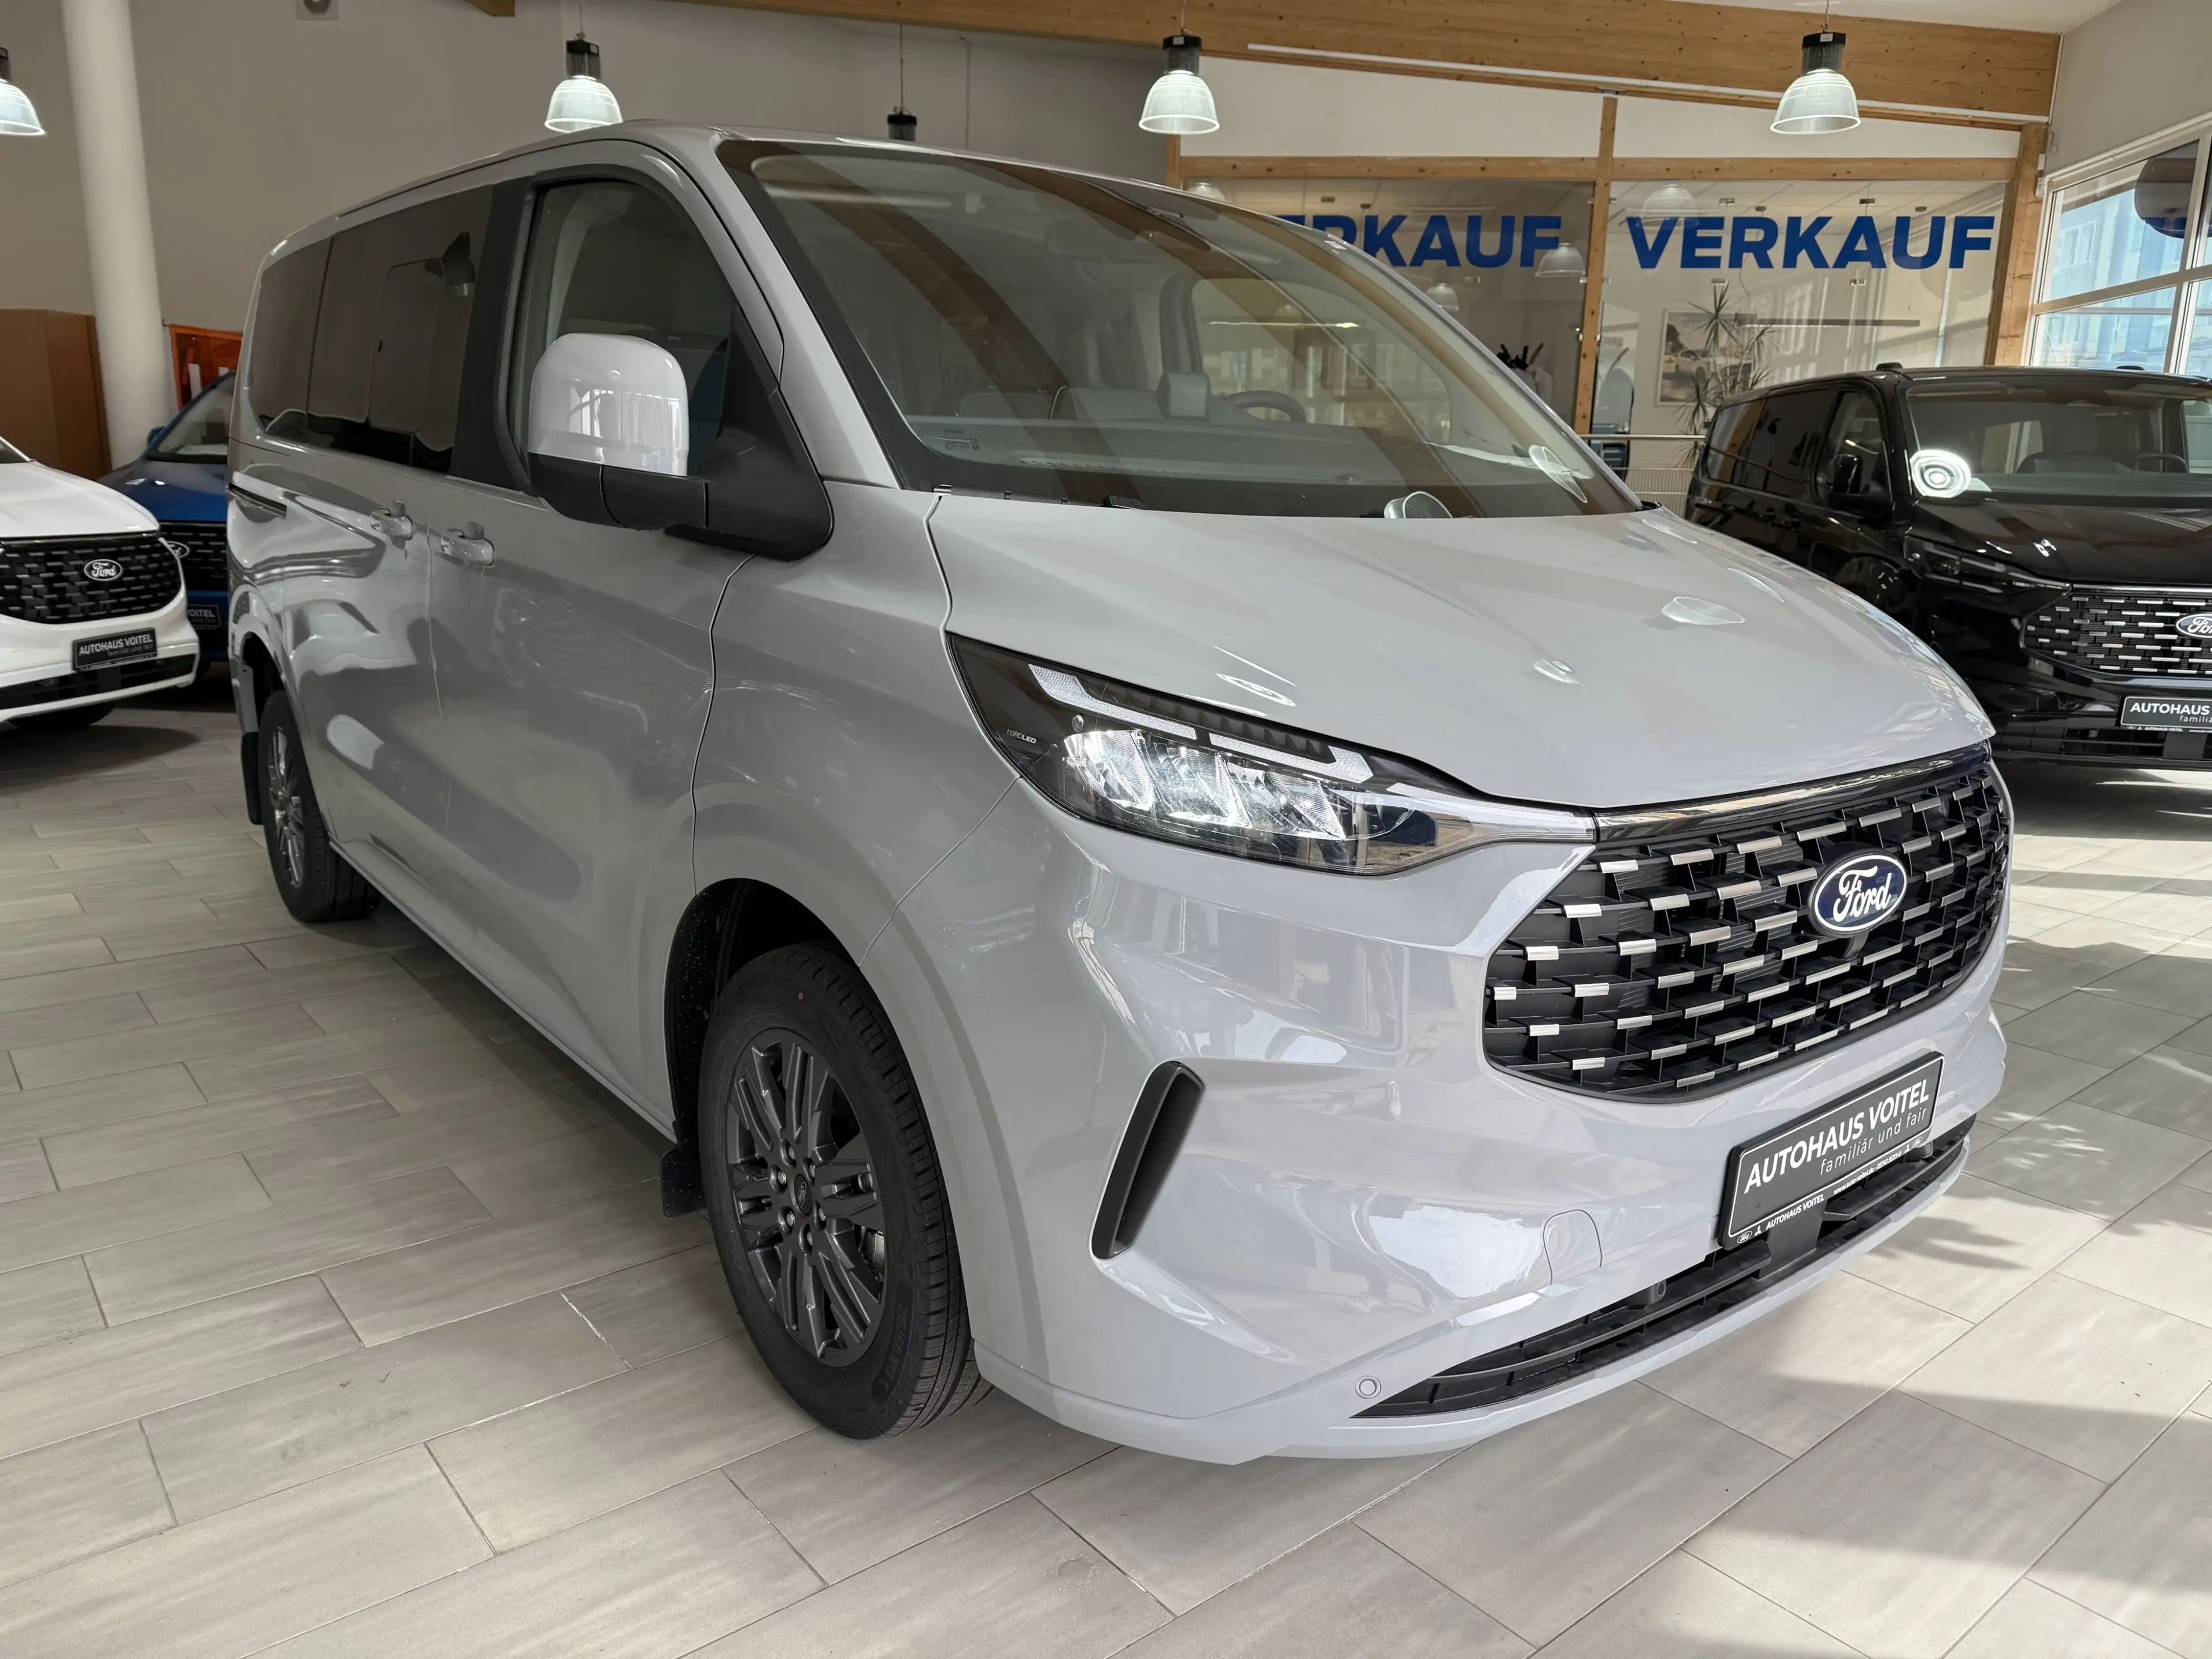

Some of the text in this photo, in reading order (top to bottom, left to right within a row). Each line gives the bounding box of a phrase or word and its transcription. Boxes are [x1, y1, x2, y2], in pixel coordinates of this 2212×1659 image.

[1626, 215, 1995, 269] VERKAUF
[91, 562, 116, 578] Ford
[187, 608, 216, 618] OITEL
[78, 638, 124, 656] AUTOHAUS
[124, 634, 153, 646] VOITEL
[2130, 702, 2210, 715] AUTOHAUS
[1832, 865, 1892, 922] Ford
[1744, 1079, 1929, 1194] AUTOHAUS VOITEL
[1820, 1135, 1873, 1175] familiär
[1878, 1118, 1902, 1143] und
[1906, 1107, 1927, 1128] fair
[1766, 1205, 1802, 1230] AUTOHAUS
[1802, 1194, 1824, 1210] VOITEL
[1834, 1167, 1874, 1195] www.auto-voitel.de
